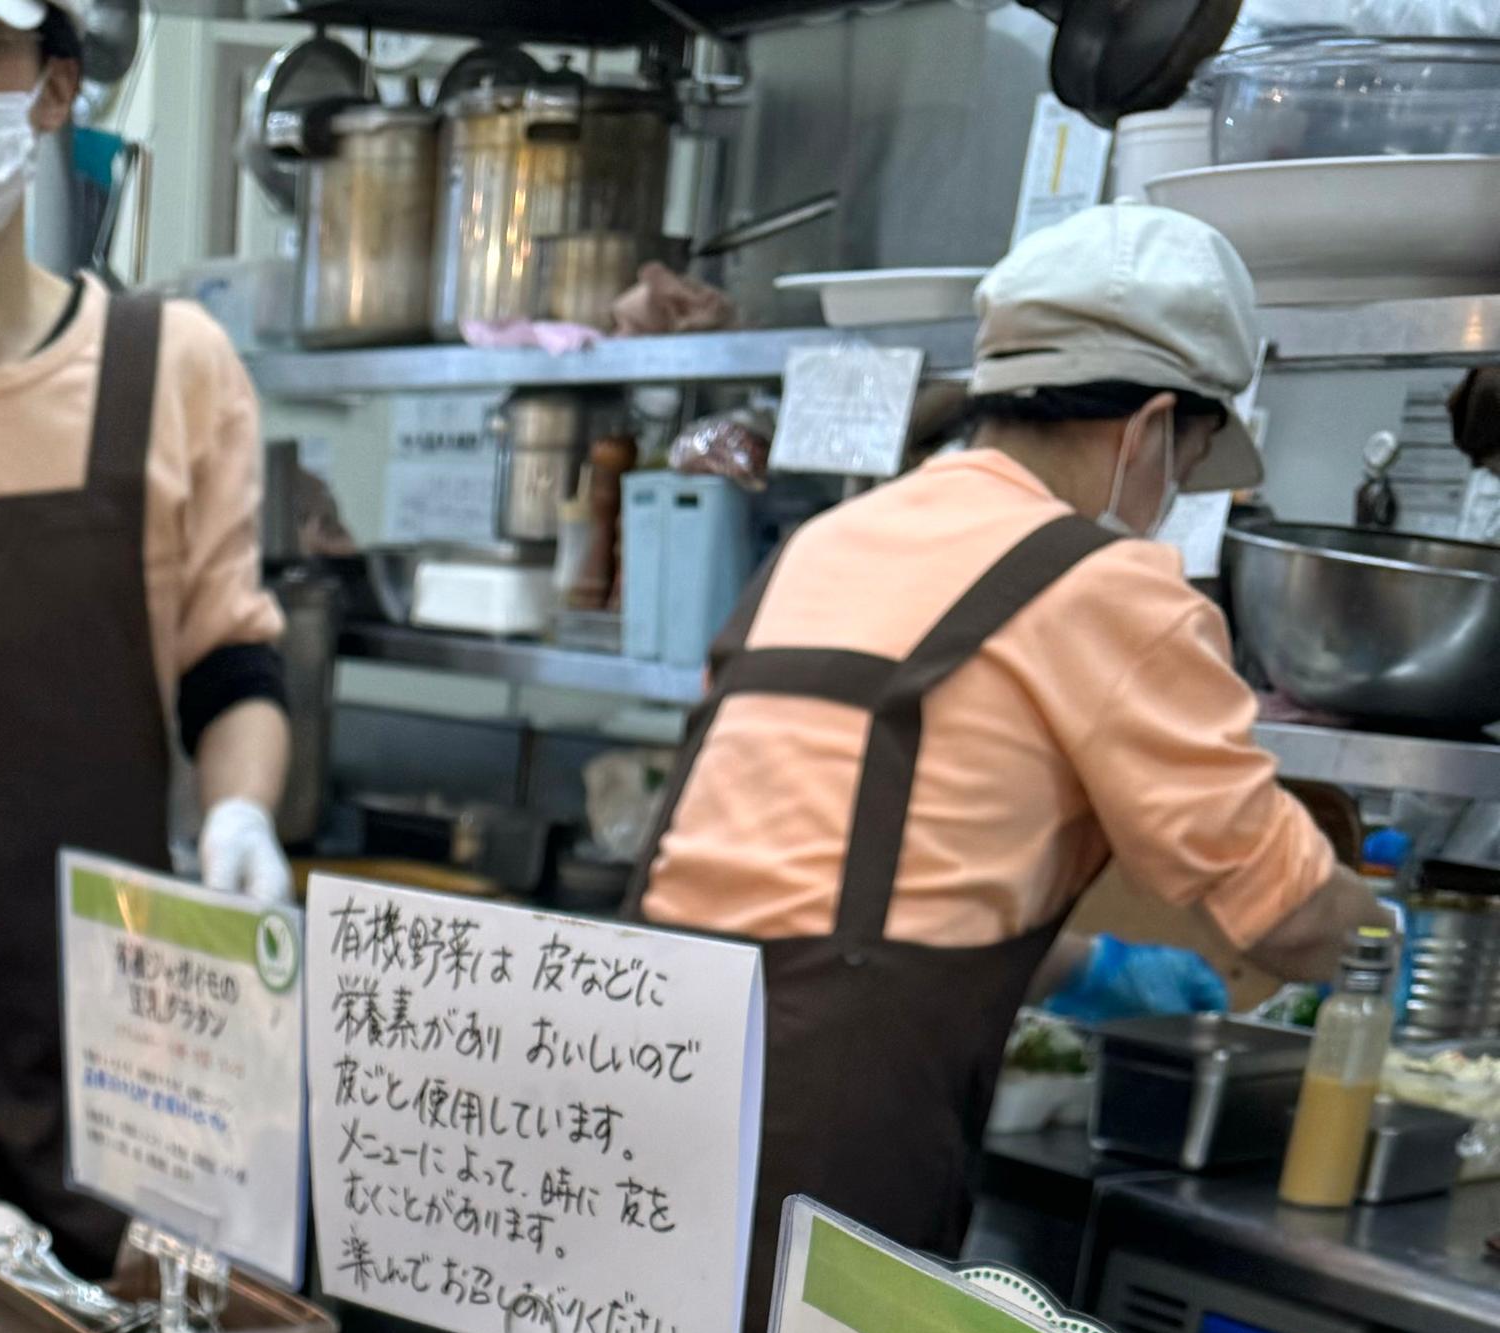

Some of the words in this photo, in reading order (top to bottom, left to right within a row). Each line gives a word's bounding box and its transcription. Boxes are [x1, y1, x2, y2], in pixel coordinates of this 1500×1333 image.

[329, 893, 513, 991] 有機野菜は
[533, 931, 667, 1007] 皮などに
[332, 974, 501, 1063] 栄養素があり
[526, 1016, 701, 1083] おいしいので
